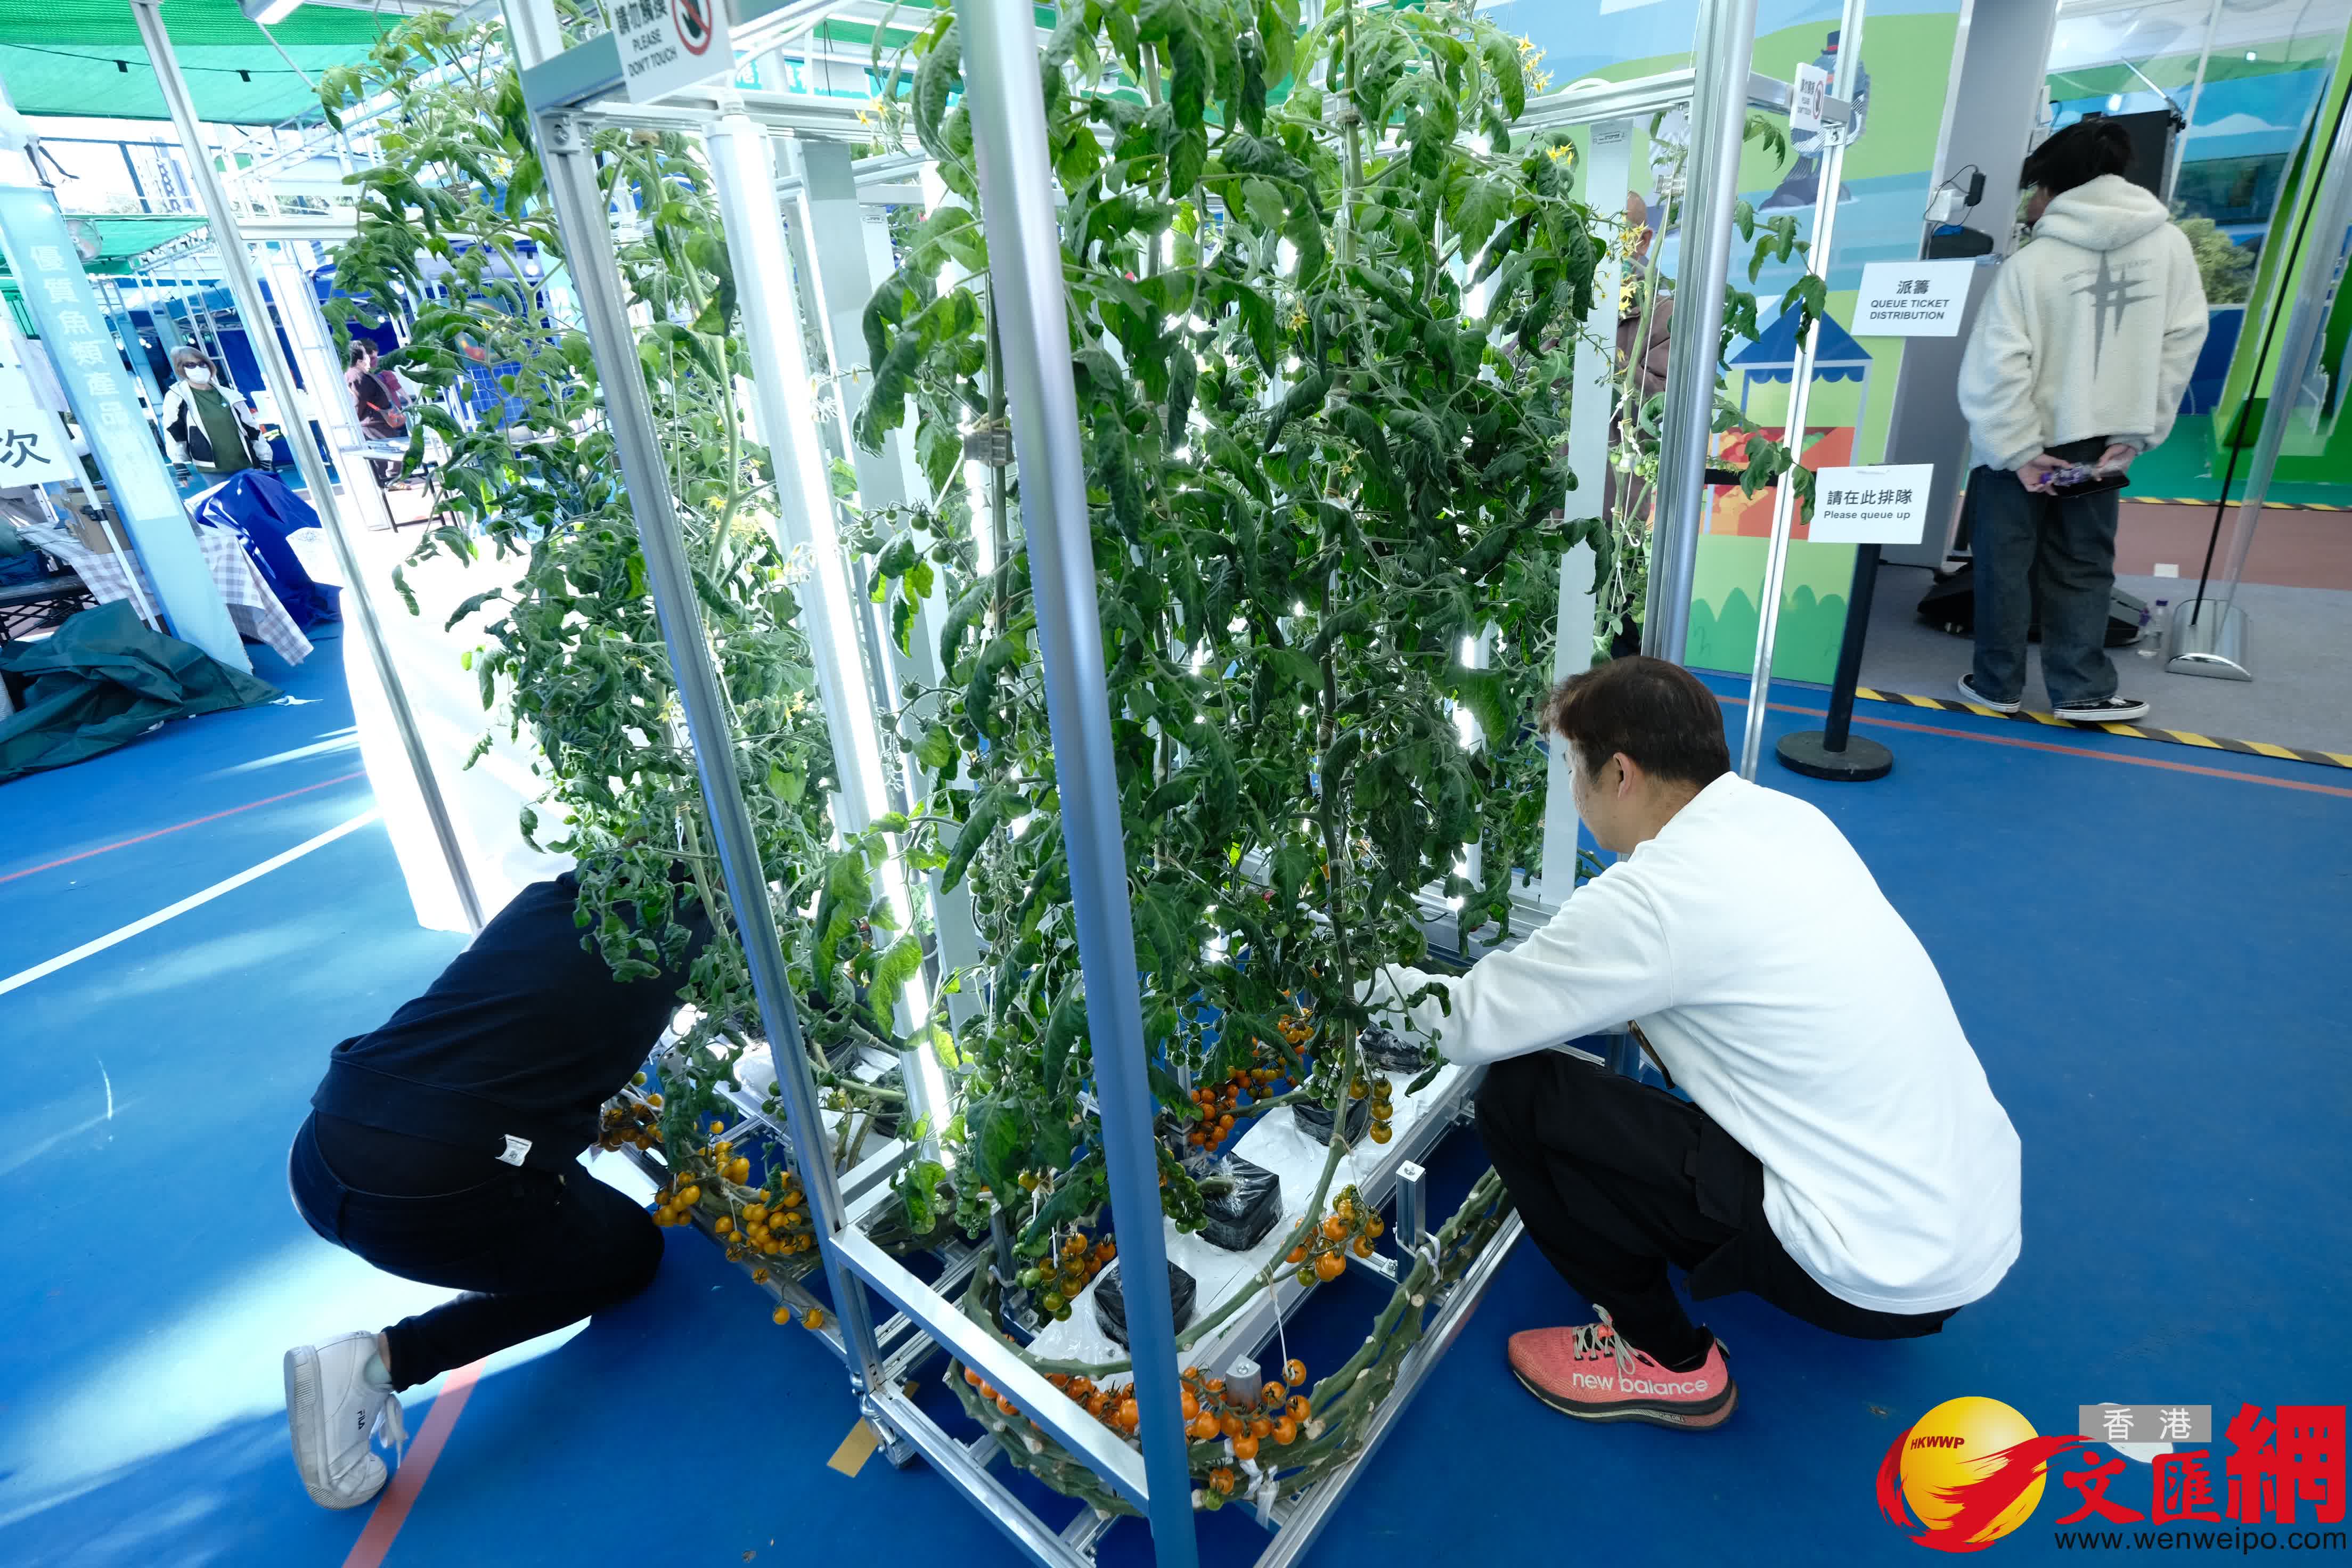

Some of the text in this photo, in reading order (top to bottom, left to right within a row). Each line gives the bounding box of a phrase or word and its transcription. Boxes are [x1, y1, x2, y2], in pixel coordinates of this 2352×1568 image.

[632, 28, 662, 52] PLEASE
[650, 46, 677, 67] TOUCH
[1896, 280, 1930, 294] 派籌
[1827, 489, 1913, 505] 請在此排隊
[1573, 1373, 1709, 1395] new balance
[357, 1409, 366, 1430] FILA
